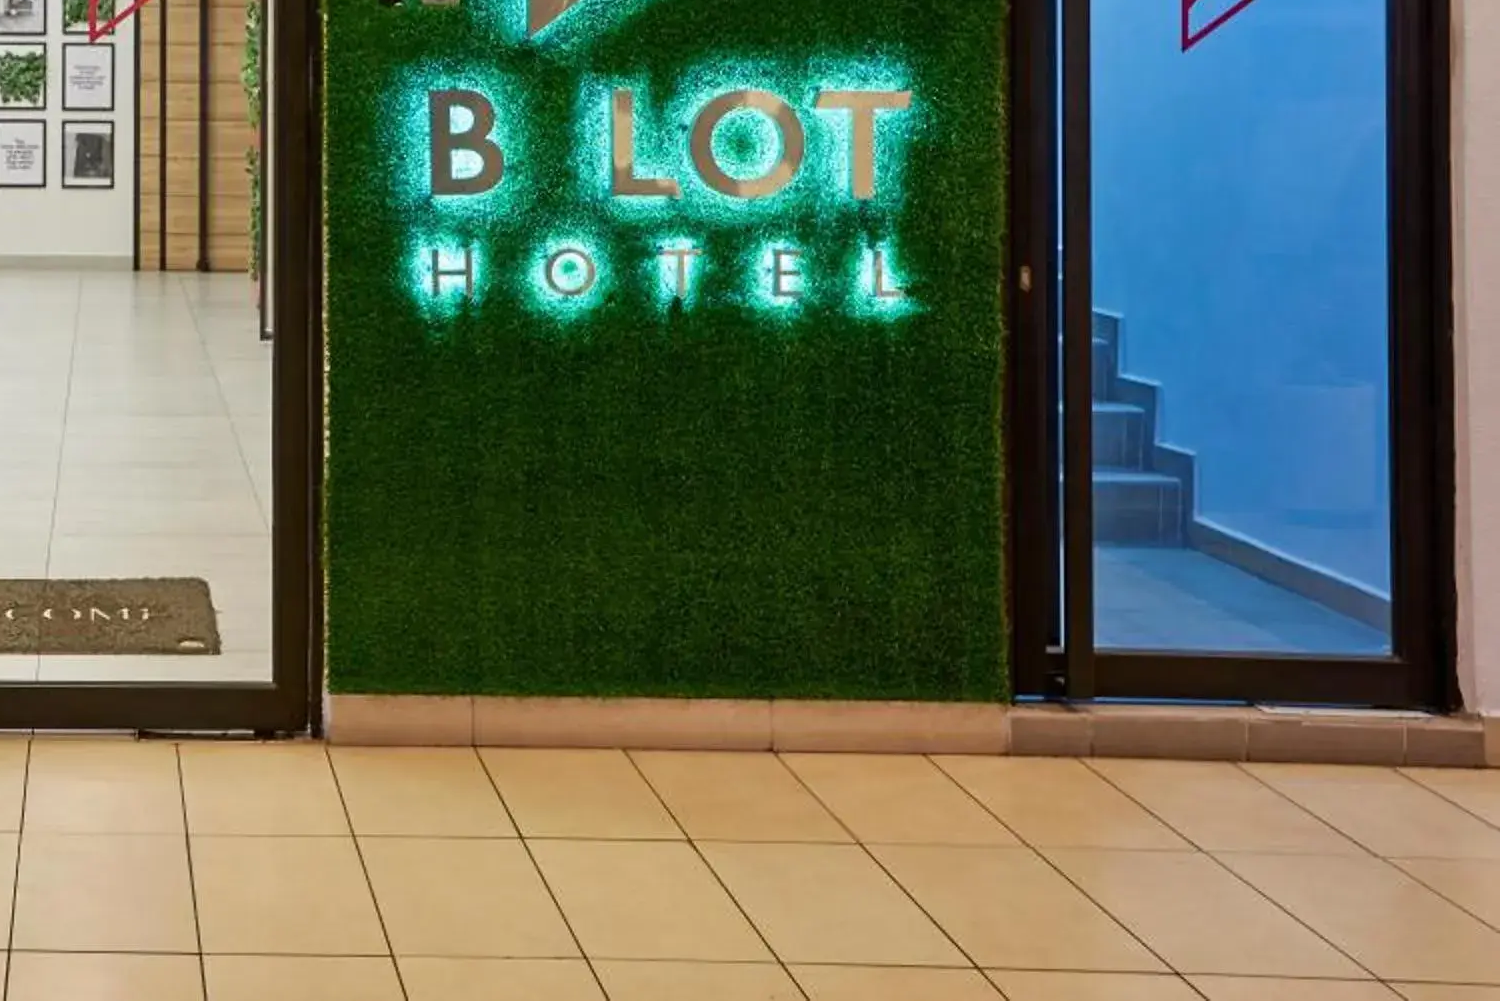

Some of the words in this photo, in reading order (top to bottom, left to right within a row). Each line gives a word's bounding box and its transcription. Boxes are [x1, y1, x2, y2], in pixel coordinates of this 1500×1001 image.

[427, 88, 505, 197] B
[611, 88, 913, 200] LOT
[430, 247, 907, 299] HOTEL
